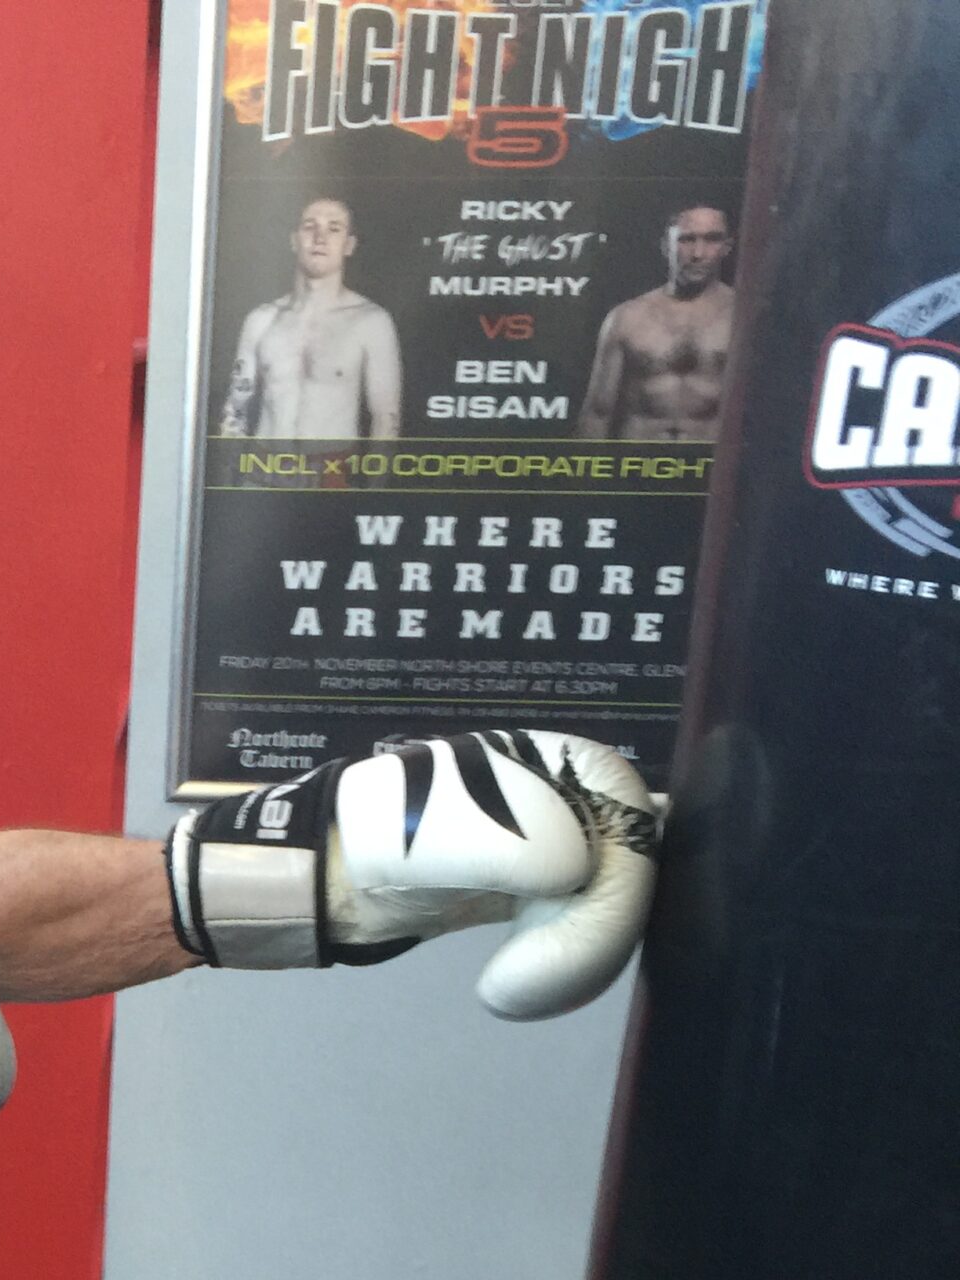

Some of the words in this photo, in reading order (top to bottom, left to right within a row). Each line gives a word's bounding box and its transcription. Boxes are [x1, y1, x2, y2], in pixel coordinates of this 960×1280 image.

[261, 0, 517, 141] FIGHT
[531, 0, 762, 133] NIGH
[467, 105, 568, 168] 5
[460, 200, 574, 221] RICKY
[429, 275, 590, 297] MURPHY
[479, 314, 535, 340] VS
[455, 360, 547, 385] BEN
[426, 397, 569, 420] SISAM
[812, 335, 960, 471] CA
[240, 453, 317, 475] INCL
[344, 453, 388, 476] 10
[392, 453, 615, 478] CORPORATE
[355, 514, 618, 548] WHERE
[280, 560, 686, 596] WARRIORS
[825, 567, 940, 600] WHERE
[290, 607, 428, 639] ARE
[458, 609, 665, 642] MADE
[219, 655, 271, 669] FRIDAY
[314, 657, 398, 672] NOVEMBER
[400, 658, 454, 673] NORTH
[456, 660, 509, 674] SHORE
[512, 661, 572, 676] EVENTS
[413, 676, 470, 692] FIGHTS
[473, 678, 528, 693] START
[530, 680, 552, 693] AT
[239, 749, 314, 770] Tavern
